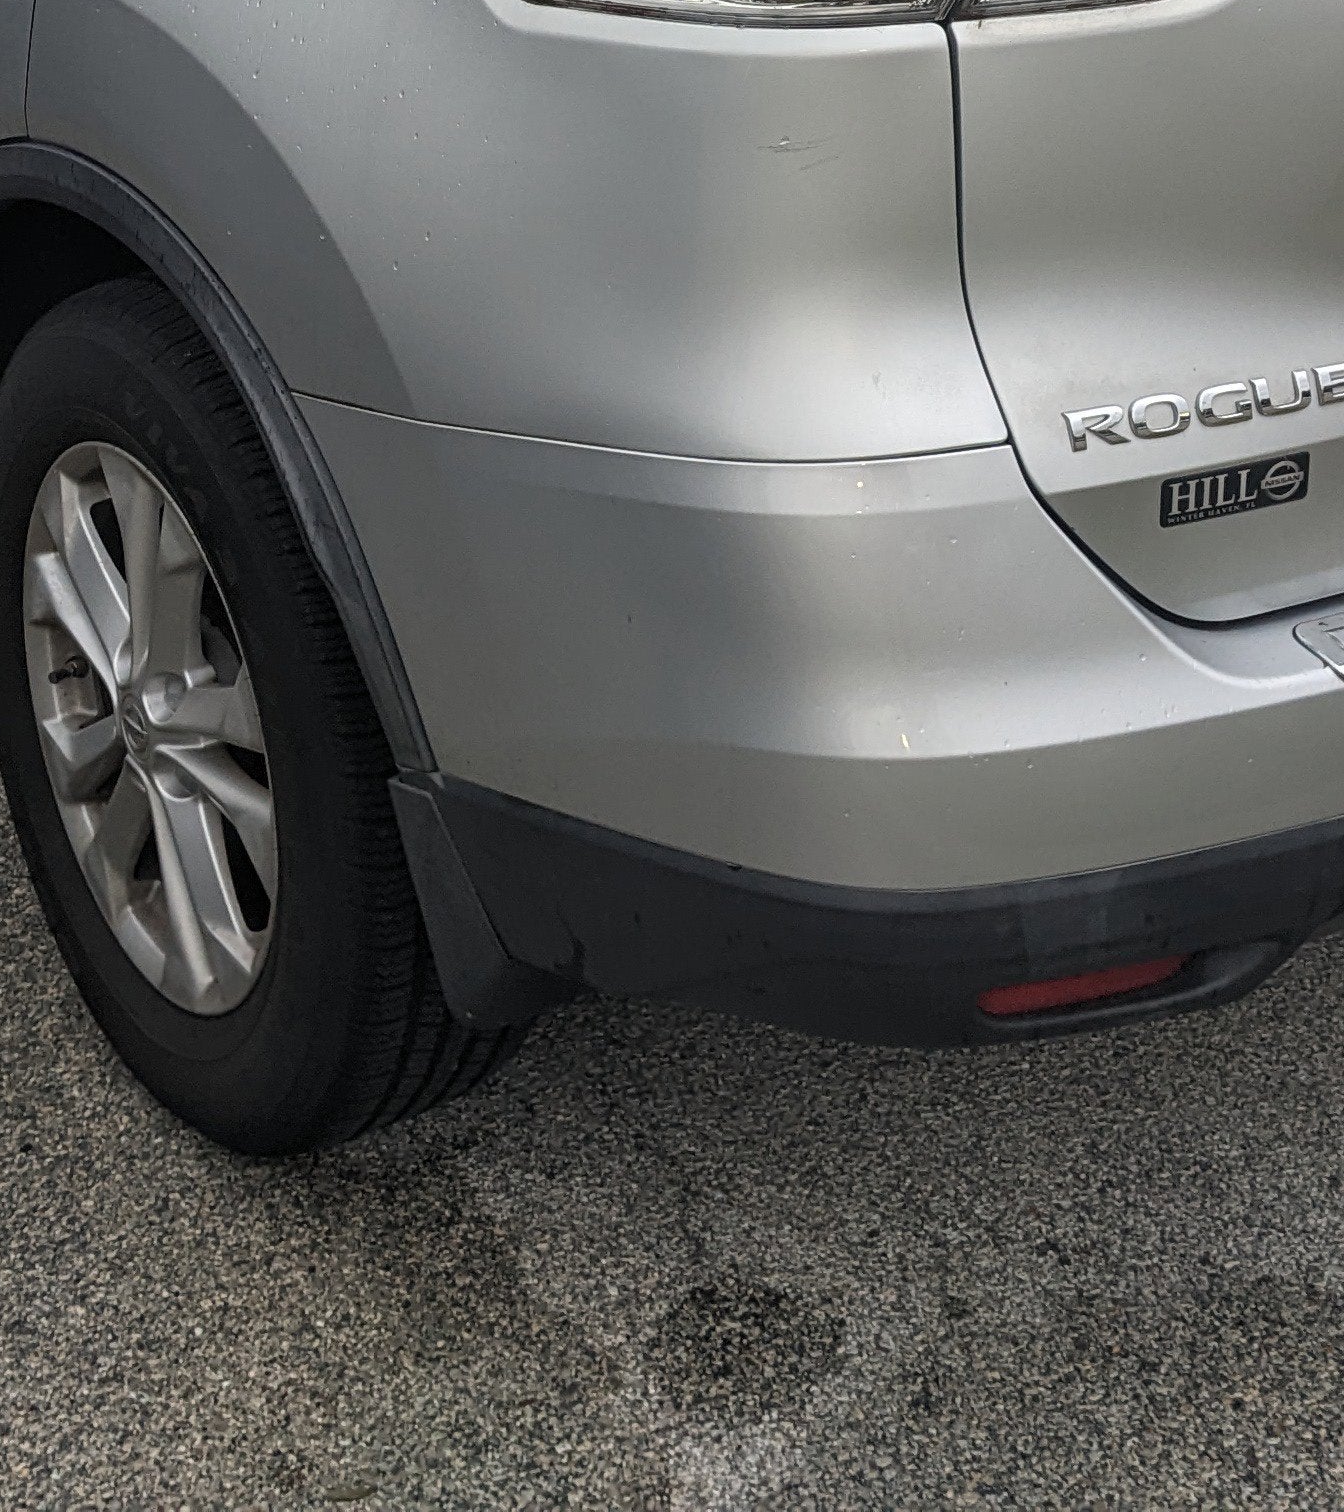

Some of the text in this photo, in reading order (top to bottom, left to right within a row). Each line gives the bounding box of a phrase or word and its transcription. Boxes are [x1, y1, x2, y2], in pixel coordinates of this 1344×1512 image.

[1168, 469, 1301, 516] HILL NISSAN
[1167, 511, 1204, 524] WINTER
[1208, 505, 1240, 516] HAVEN
